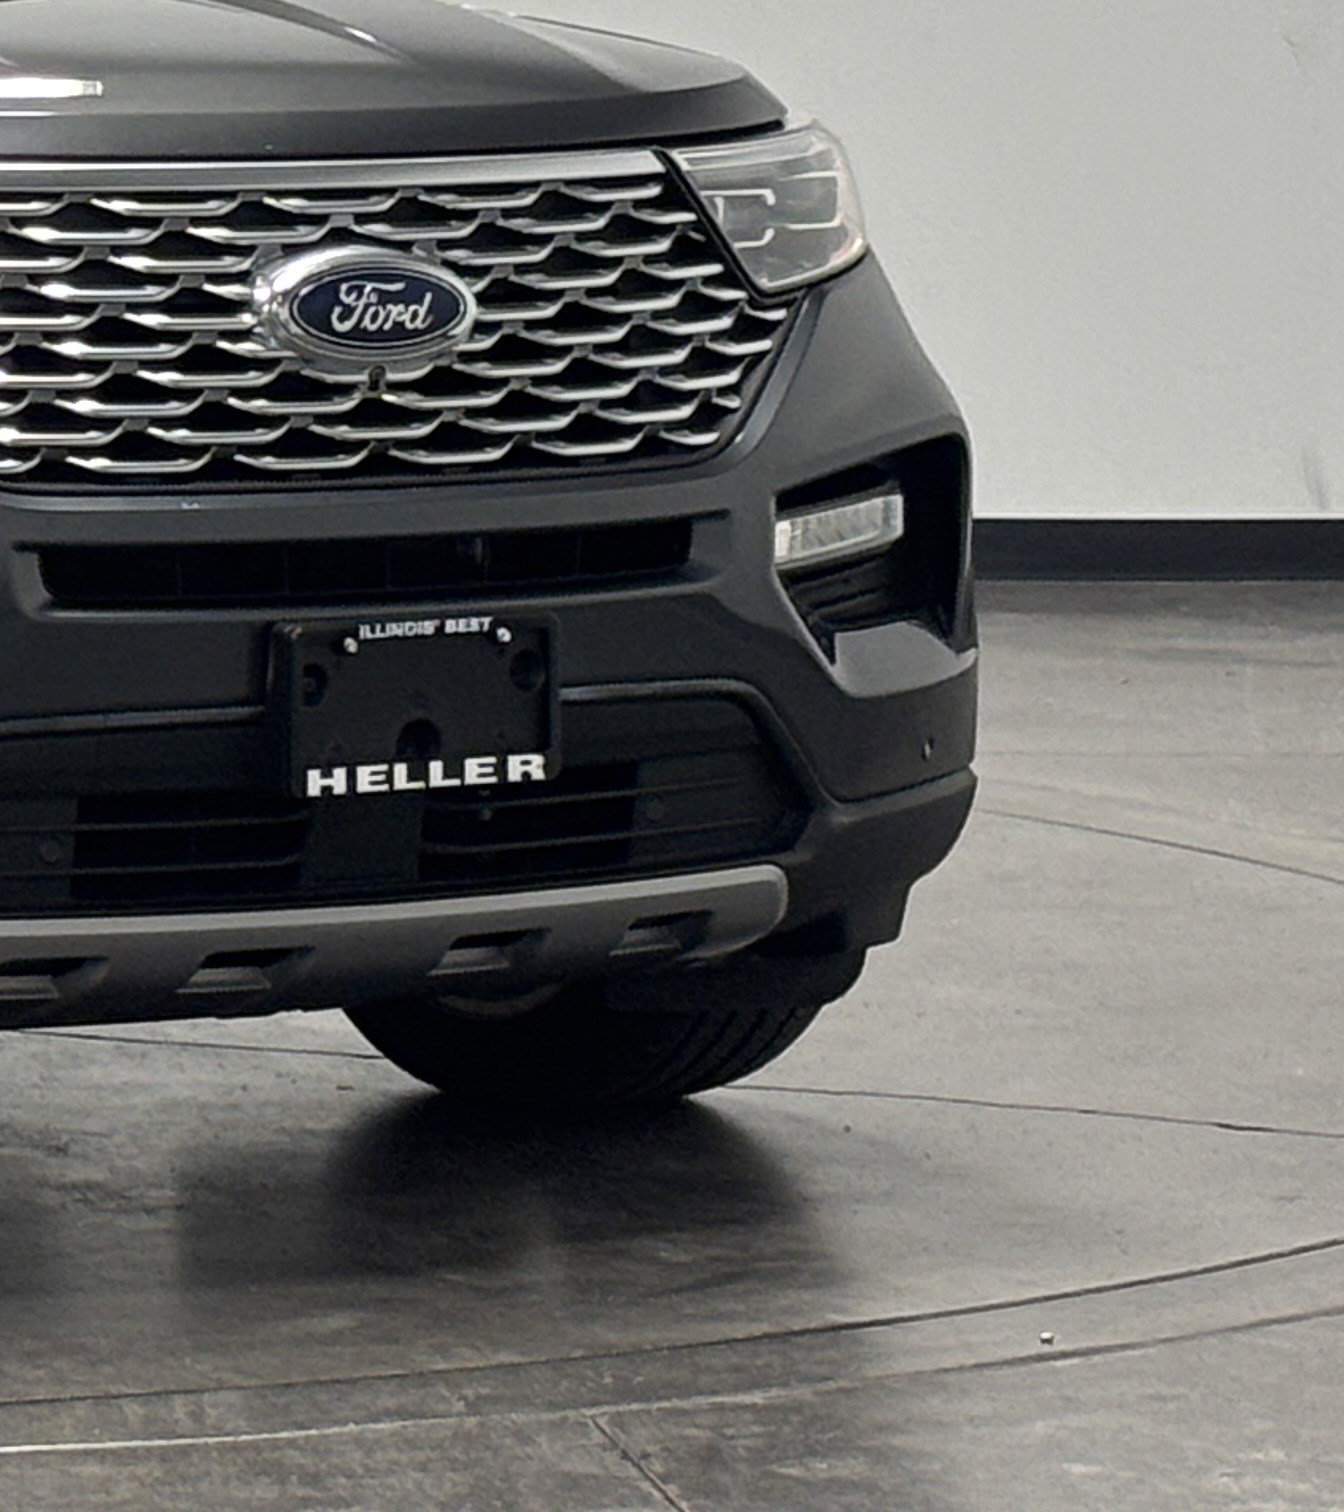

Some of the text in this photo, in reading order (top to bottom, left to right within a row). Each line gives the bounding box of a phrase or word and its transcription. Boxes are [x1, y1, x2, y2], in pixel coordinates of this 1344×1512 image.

[330, 281, 433, 333] Ford
[444, 616, 494, 634] BEST
[306, 753, 546, 797] HELLER
